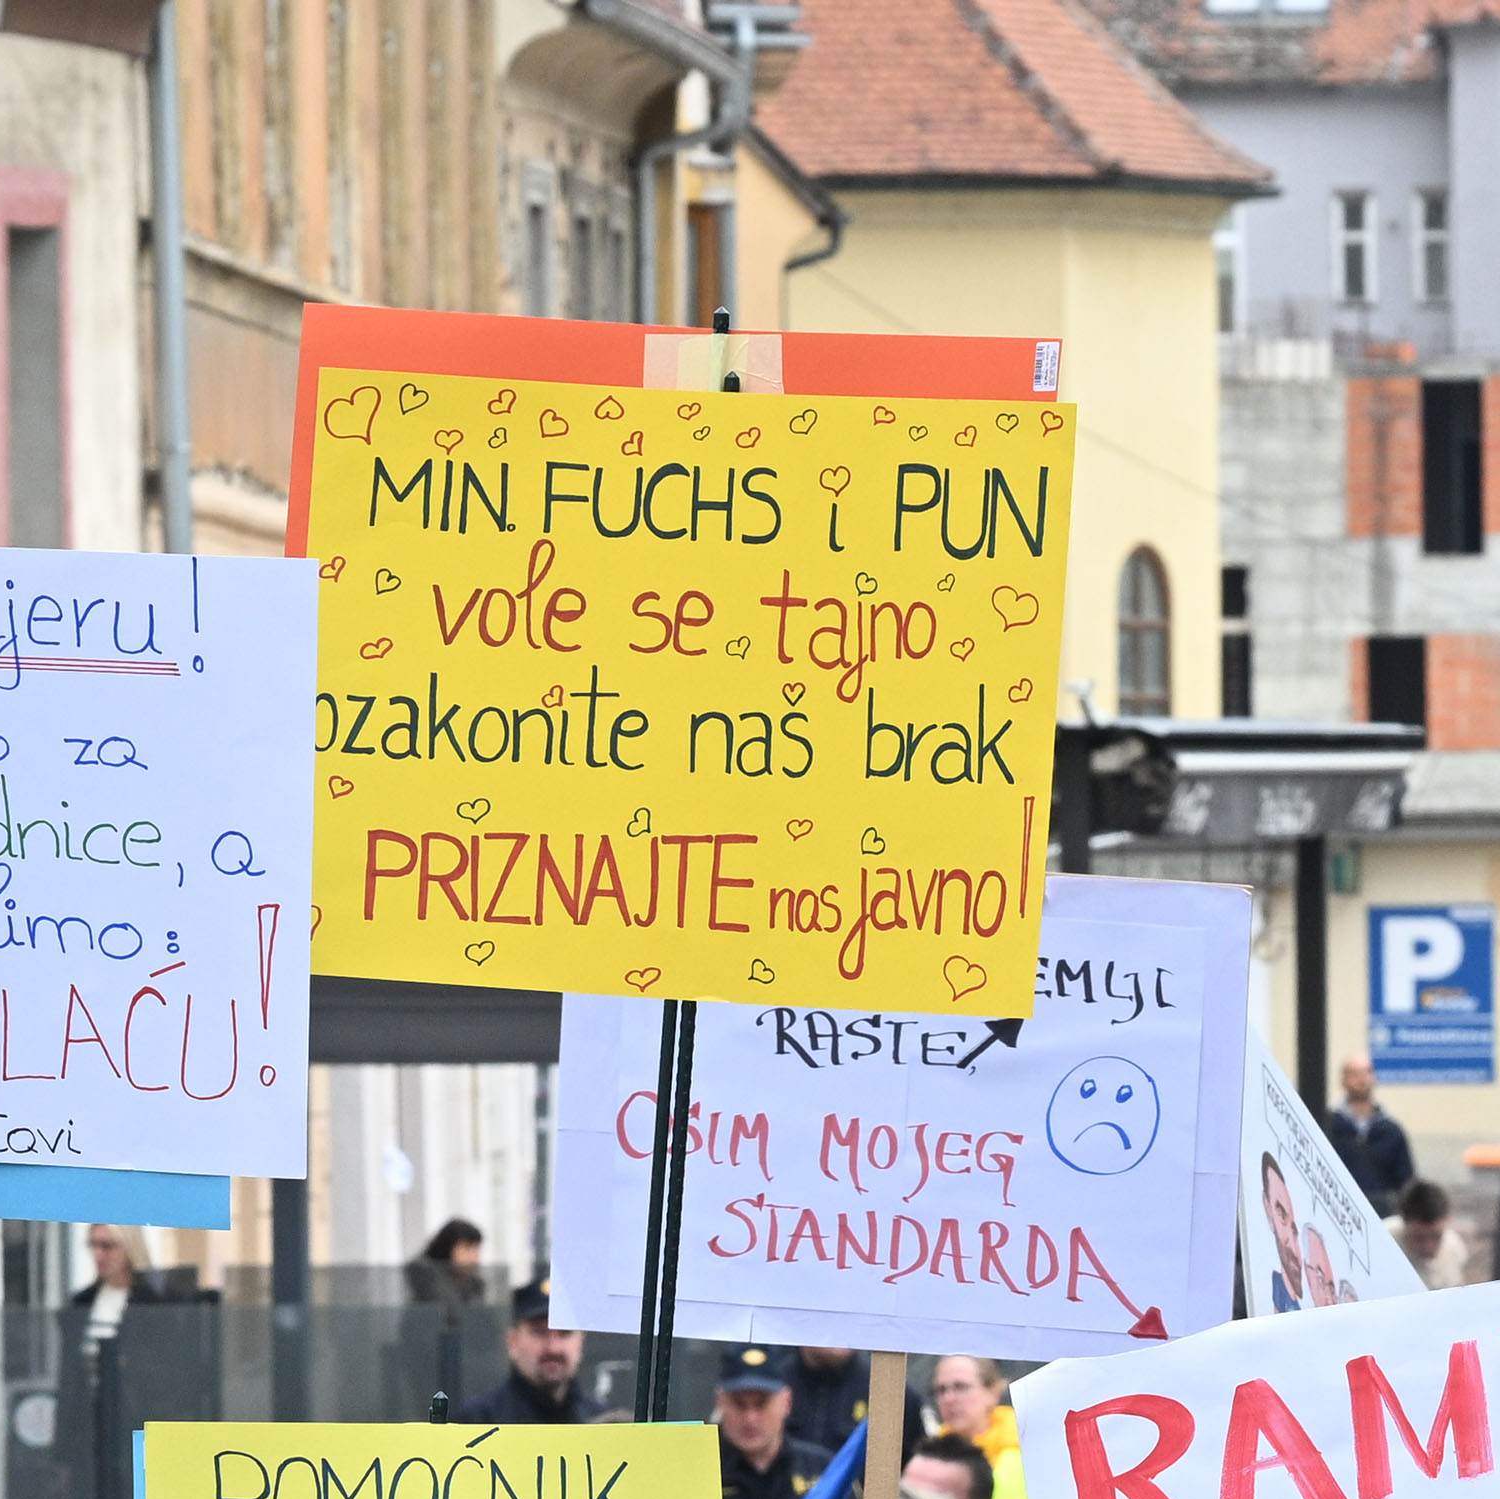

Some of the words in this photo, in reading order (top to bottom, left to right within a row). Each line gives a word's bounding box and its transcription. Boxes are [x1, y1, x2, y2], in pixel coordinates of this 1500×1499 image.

[369, 457, 516, 534] MIN.
[543, 461, 781, 545] FUCHS
[893, 462, 1049, 560] PUN
[432, 540, 586, 652] vole
[629, 589, 714, 656] se
[760, 569, 937, 704] tajno
[71, 737, 148, 770] za
[866, 684, 1015, 785] brak
[211, 831, 266, 877] a
[364, 828, 758, 933] PRIZNAJTE
[768, 873, 841, 935] nas
[1382, 916, 1465, 1012] P
[819, 1113, 1026, 1208] MOJEG
[708, 1193, 1125, 1303] STANDARDA
